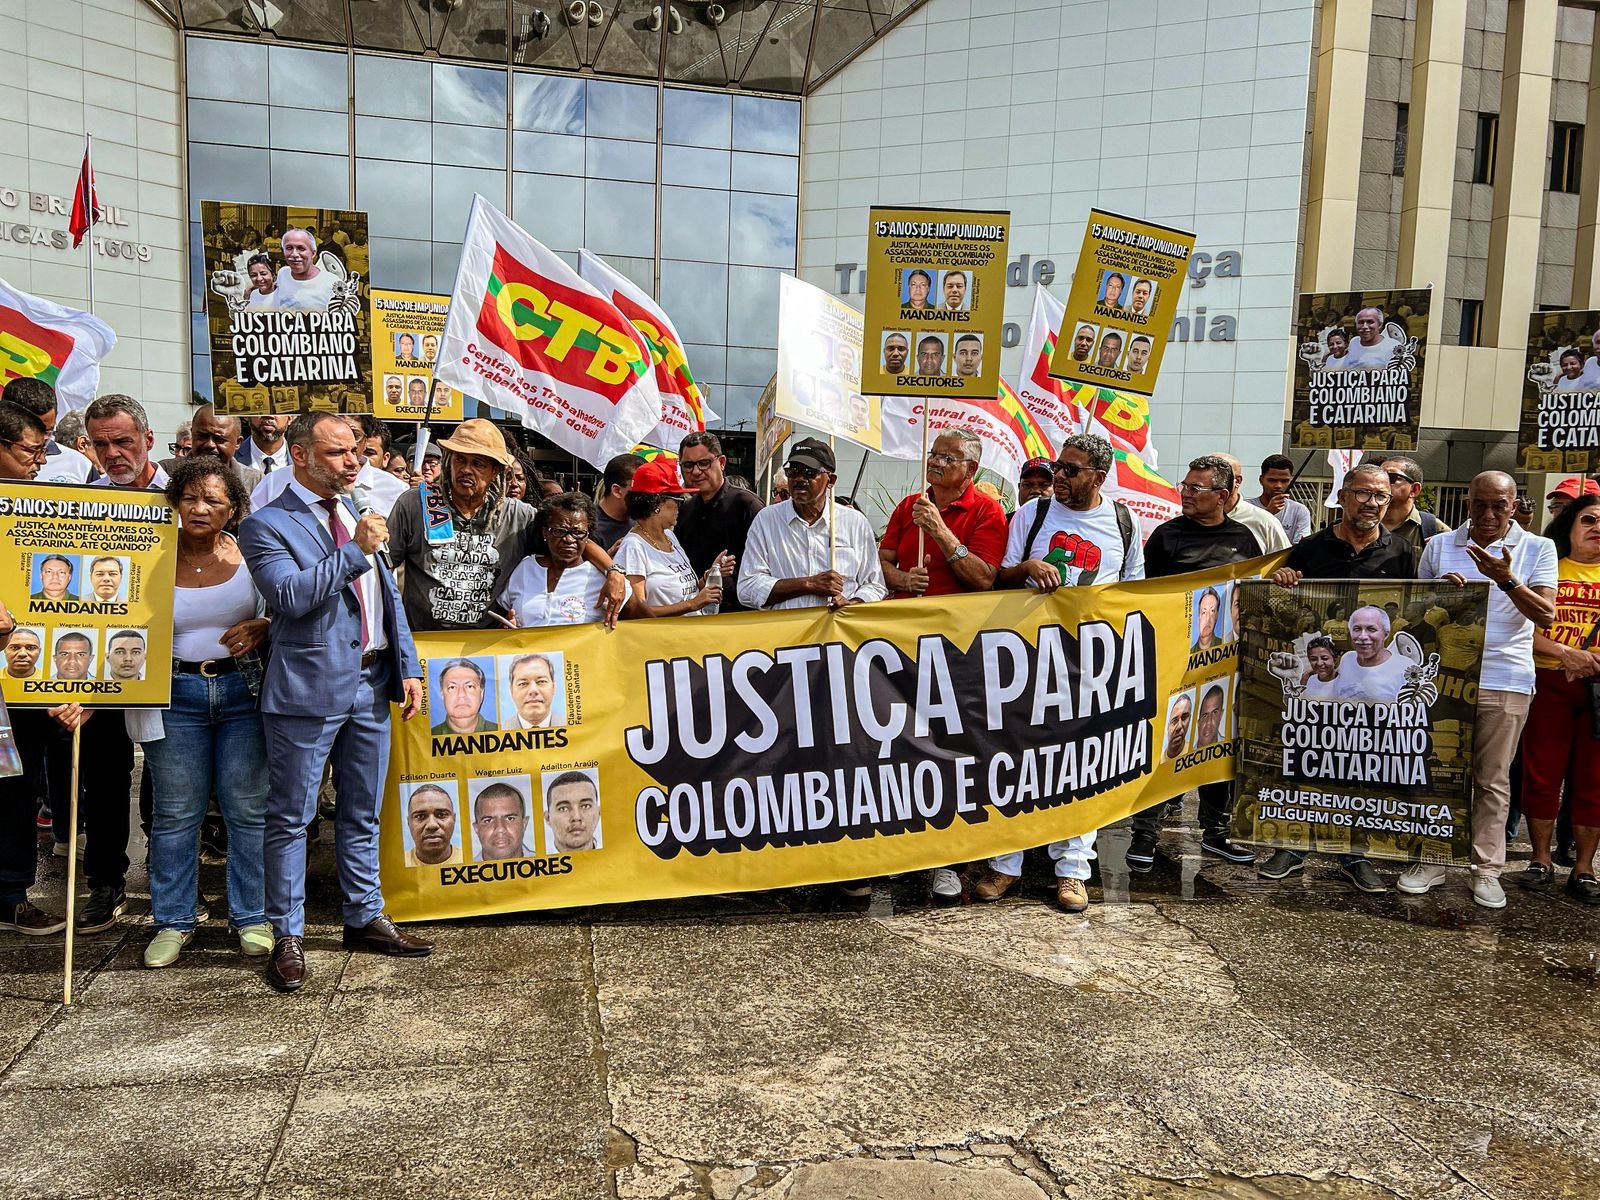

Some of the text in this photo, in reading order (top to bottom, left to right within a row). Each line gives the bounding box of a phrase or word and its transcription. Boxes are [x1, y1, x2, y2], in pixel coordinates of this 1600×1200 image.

[29, 190, 129, 227] BRSIL
[875, 221, 1004, 241] 15 ANOS DE IMPUNIDADE
[1091, 223, 1190, 260] 15 ANOS DE IMPUNIDADE
[93, 237, 152, 262] 1609
[885, 248, 932, 257] ASSASSINOS
[943, 250, 995, 260] COLOMBIANO
[920, 240, 953, 250] MANTÉM
[954, 243, 978, 251] LIVRES
[979, 244, 991, 252] OS
[1094, 250, 1131, 262] ASSASSINOS
[950, 259, 989, 267] QUANDO?
[1007, 253, 1056, 288] de
[383, 299, 404, 311] ANOS
[404, 301, 416, 312] DE
[899, 309, 970, 322] MANDANTES
[1093, 305, 1148, 325] MANDANTES
[229, 311, 356, 335] JUSTIÇA PARA
[496, 282, 640, 385] CTB
[231, 332, 357, 357] COLOMBIANO
[235, 354, 359, 383] E CATARINA
[1078, 363, 1131, 381] EXECUTORES
[1308, 368, 1409, 389] JUSTIÇA PARA
[467, 342, 607, 430] Central dos Trabalhadores
[897, 376, 965, 388] EXECUTORES
[462, 355, 598, 440] e Trabalhadoras do Brasil
[1308, 385, 1408, 406] COLOMBIANO
[1020, 390, 1073, 426] Central dos
[1308, 403, 1407, 426] E CATARINA
[907, 417, 918, 425] e
[967, 413, 994, 429] dos
[1537, 428, 1548, 448] E
[12, 497, 56, 515] ANOS
[57, 500, 76, 517] DE
[78, 501, 171, 523] IMPUNIDADE
[6, 528, 160, 544] ASSASSINOS DE COLOMBIANO
[57, 522, 102, 532] MANTÉM
[104, 525, 137, 534] LIVRES
[138, 527, 154, 535] OS
[14, 538, 21, 546] E
[21, 539, 78, 549] CATARINA.
[99, 542, 152, 551] QUANDO?
[28, 600, 129, 616] MANDANTES
[23, 681, 123, 694] EXECUTORES
[626, 612, 1147, 764] JUSTIÇA PARA
[566, 686, 575, 726] Claudemiro
[1281, 697, 1429, 728] JUSTIÇA PARA
[431, 728, 569, 757] MANDANTES
[1281, 722, 1428, 755] COLOMBIANO
[400, 771, 456, 781] Edilson Duarte
[475, 766, 523, 779] Wagner Luiz
[540, 760, 599, 771] Adailton Araújo
[1281, 748, 1296, 778] E
[1301, 749, 1428, 785] CATARINA
[636, 718, 1150, 847] COLOMBIANO E CATARINA
[1258, 787, 1454, 824] #QUEREMOSJUSTIÇA
[1259, 805, 1455, 839] JULGUEM OS ASSASSINOS!
[440, 856, 573, 886] EXECUTORES
